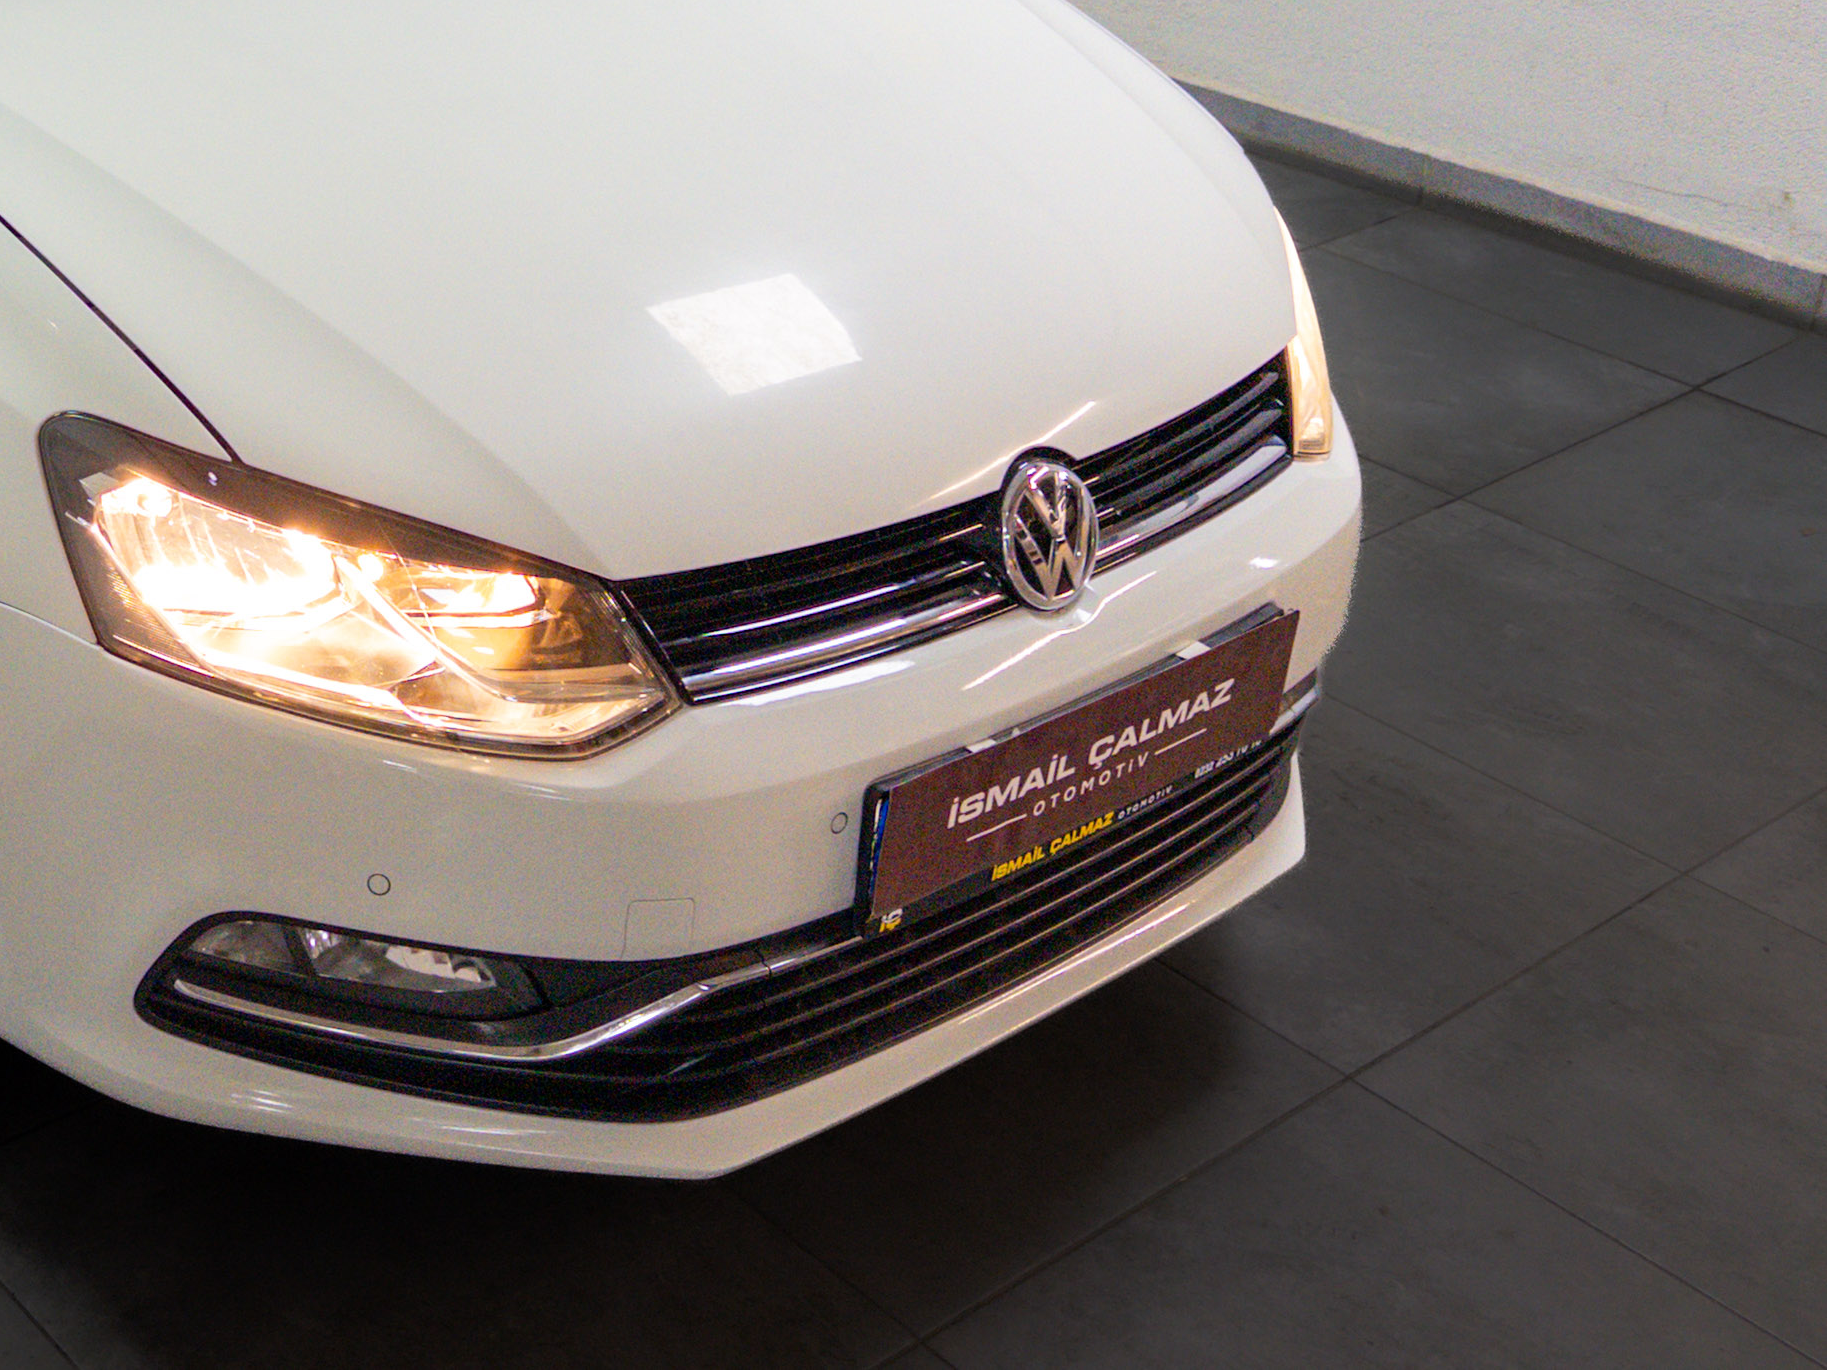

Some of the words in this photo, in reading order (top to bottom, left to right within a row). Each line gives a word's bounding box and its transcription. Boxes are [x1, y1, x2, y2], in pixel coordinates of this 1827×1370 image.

[945, 753, 1076, 829] İSMAİL
[1088, 678, 1235, 771] ÇALMAZ
[1049, 811, 1114, 856] ÇALMAZ
